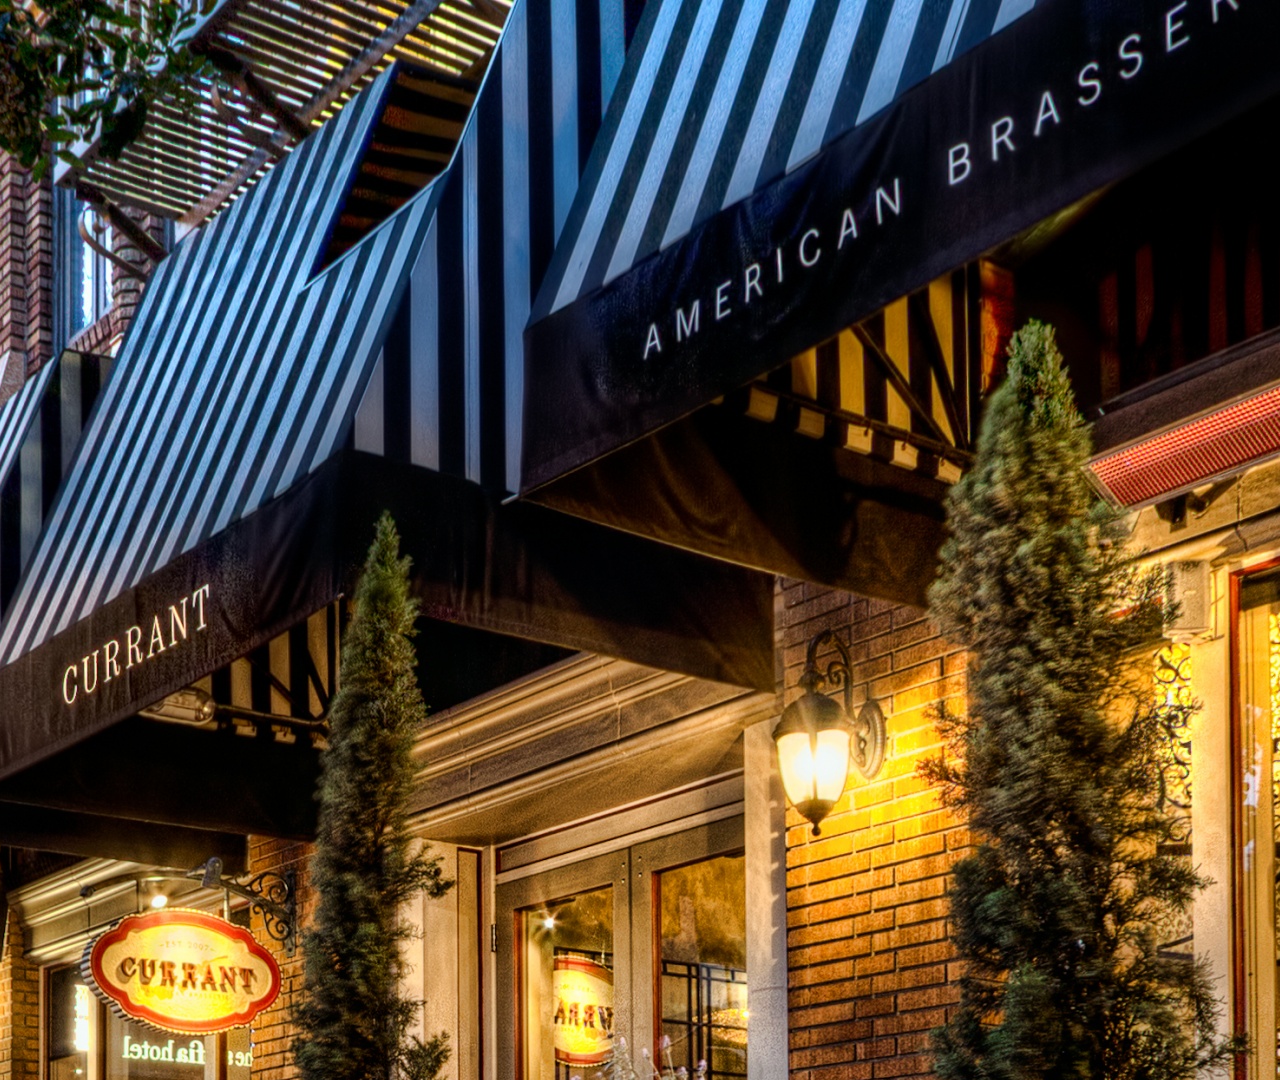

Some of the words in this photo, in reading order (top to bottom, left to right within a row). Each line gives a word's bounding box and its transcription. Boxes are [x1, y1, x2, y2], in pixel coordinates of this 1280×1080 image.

[642, 178, 902, 360] AMERICAN
[62, 583, 210, 705] CURRANT
[117, 956, 257, 995] CURRANT
